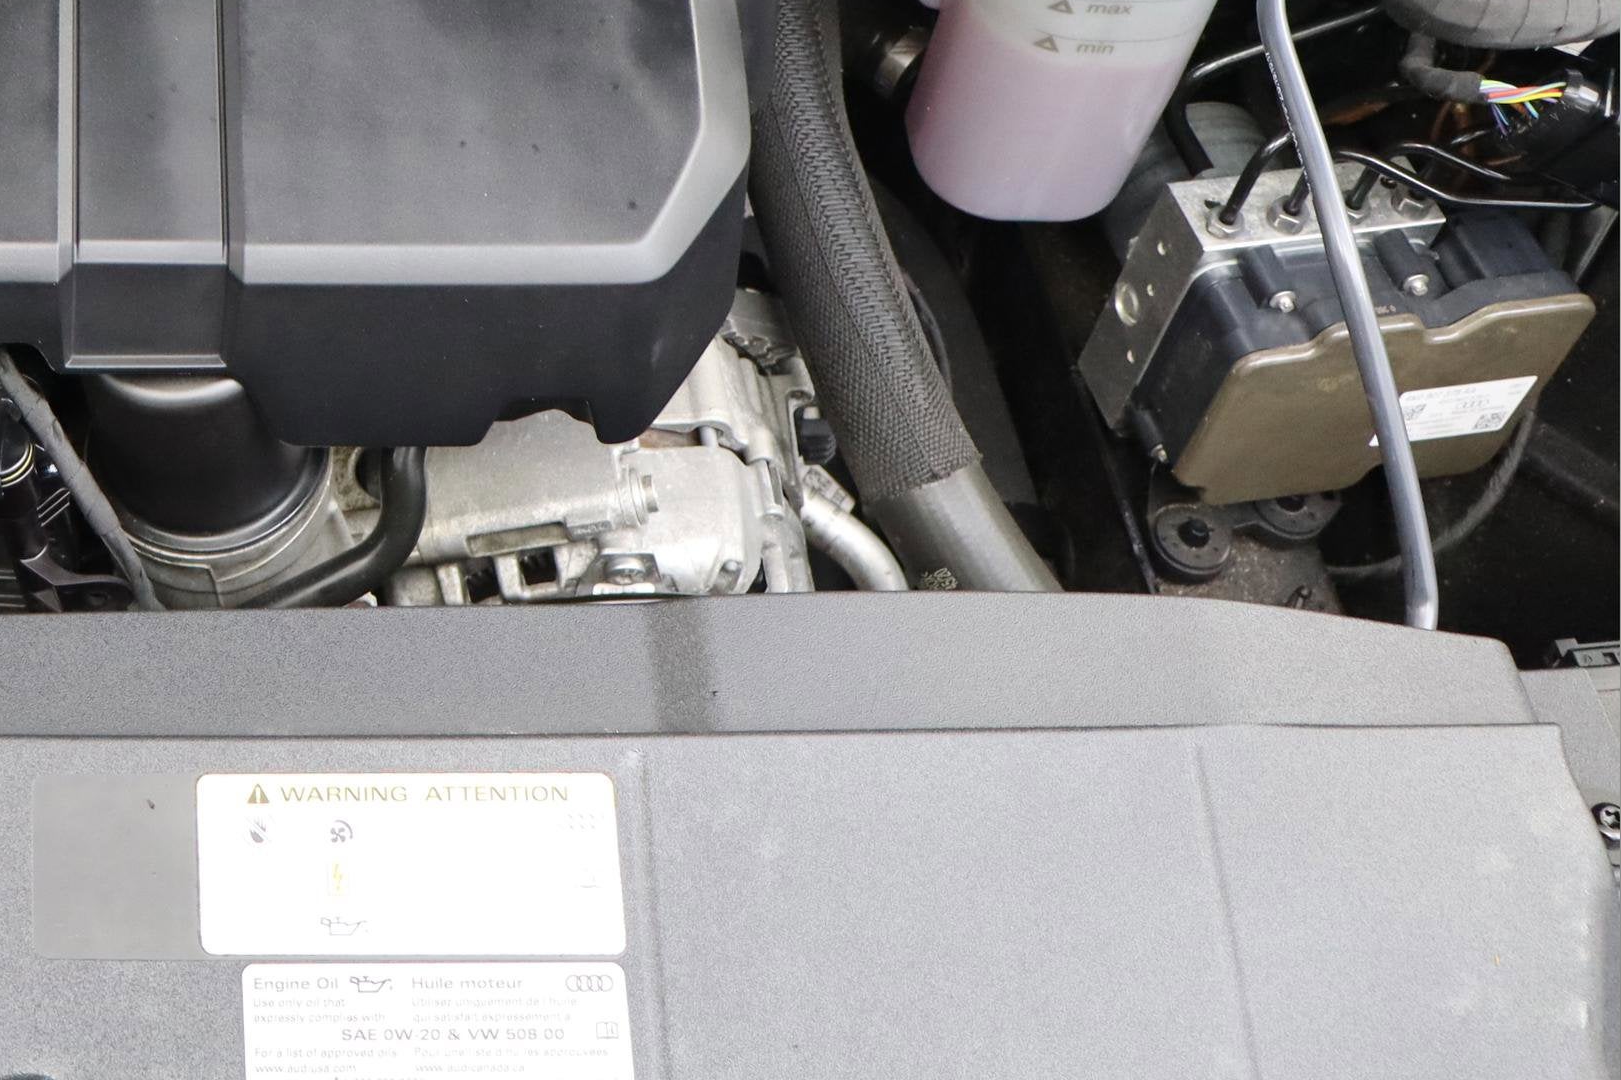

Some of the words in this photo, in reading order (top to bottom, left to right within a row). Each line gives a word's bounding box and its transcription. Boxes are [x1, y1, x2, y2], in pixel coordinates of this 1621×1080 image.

[1085, 3, 1133, 15] max
[1075, 41, 1115, 55] min
[279, 785, 409, 802] WARNING
[424, 785, 570, 802] ATTENTION
[252, 976, 311, 993] Engine
[316, 976, 339, 990] Oil
[411, 976, 454, 990] Huile
[459, 977, 523, 990] moteur
[323, 998, 347, 1008] that
[340, 1028, 378, 1041] SAE
[383, 1028, 441, 1041] 0W-20
[447, 1028, 461, 1041] &
[467, 1028, 500, 1041] VW
[505, 1028, 538, 1041] 508
[543, 1028, 565, 1041] 00
[320, 1047, 374, 1059] approved
